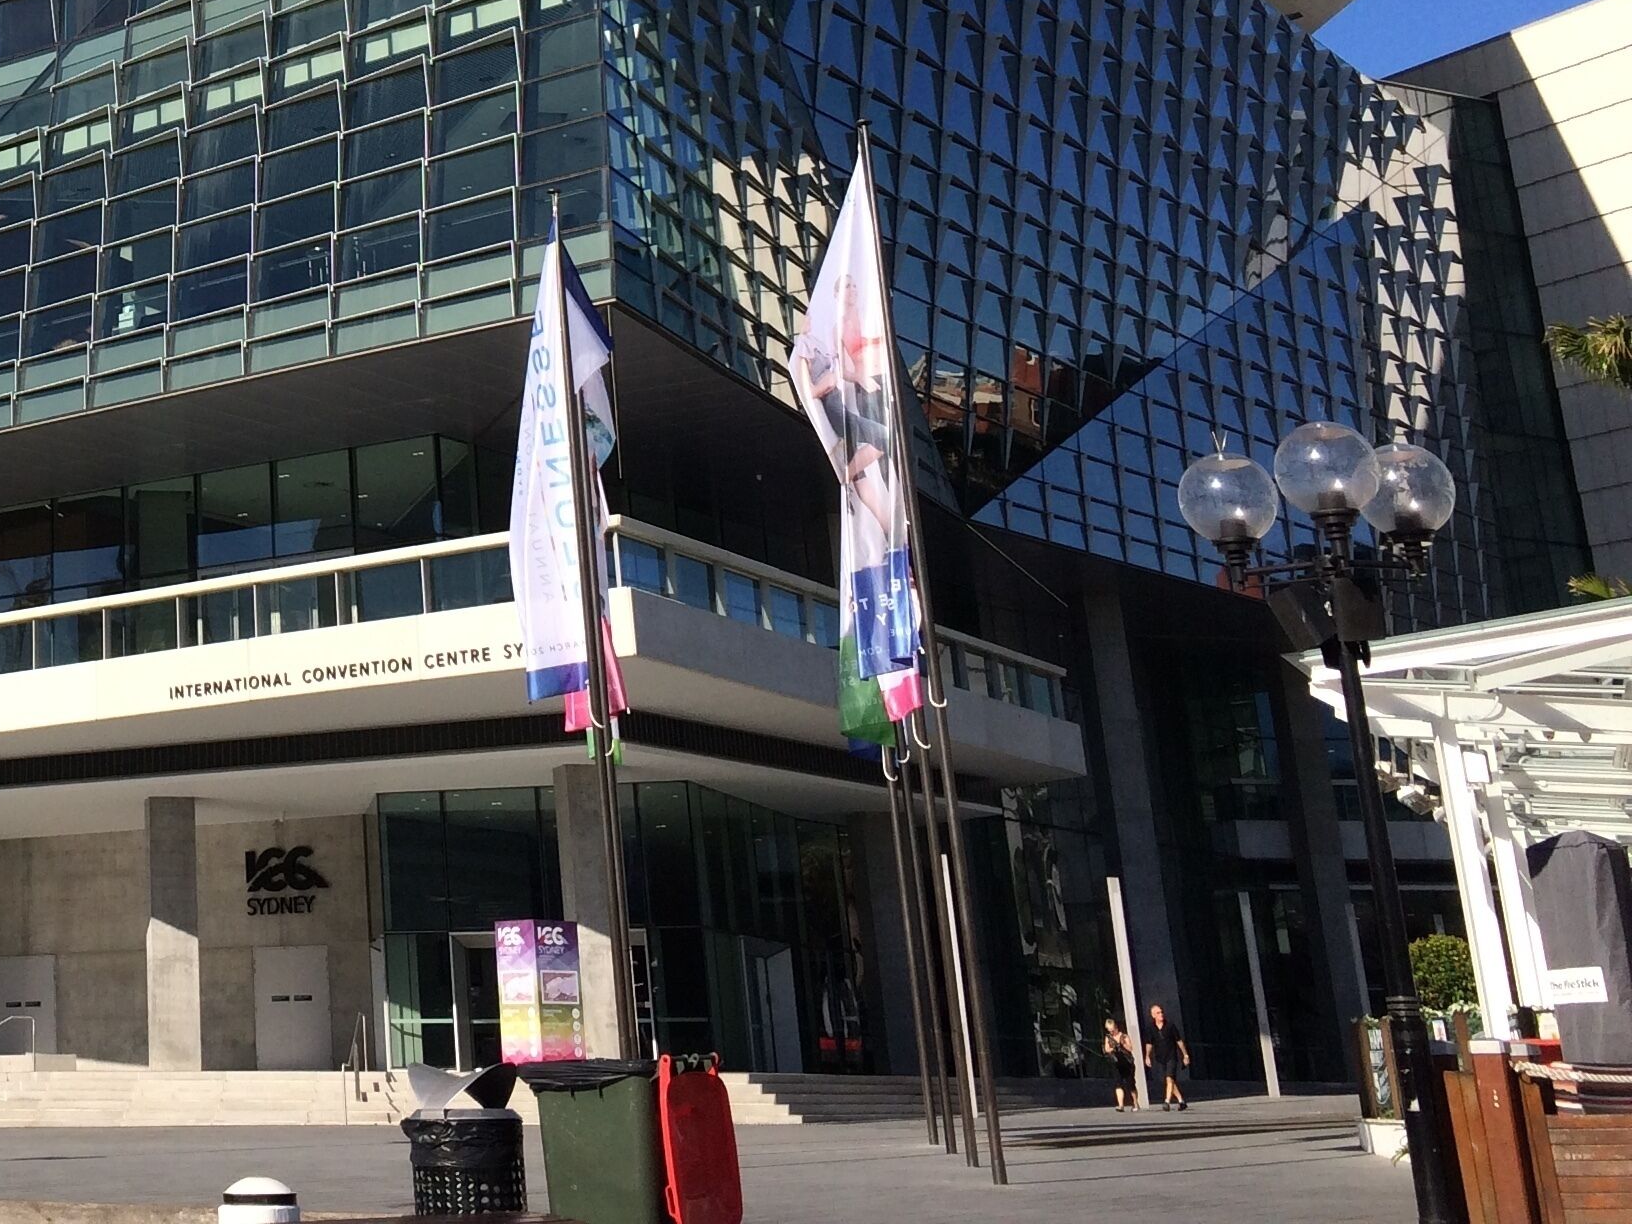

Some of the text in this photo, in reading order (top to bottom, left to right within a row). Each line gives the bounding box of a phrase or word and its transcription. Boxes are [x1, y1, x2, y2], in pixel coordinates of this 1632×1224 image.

[169, 672, 292, 700] INTERNATIONAL
[302, 655, 413, 684] CONVENTION
[424, 646, 491, 669] CENTRE
[245, 845, 330, 892] ICC
[247, 895, 316, 916] SYDNEY
[497, 926, 525, 945] ICC
[537, 926, 569, 945] ICC
[538, 945, 565, 954] SYDNEY
